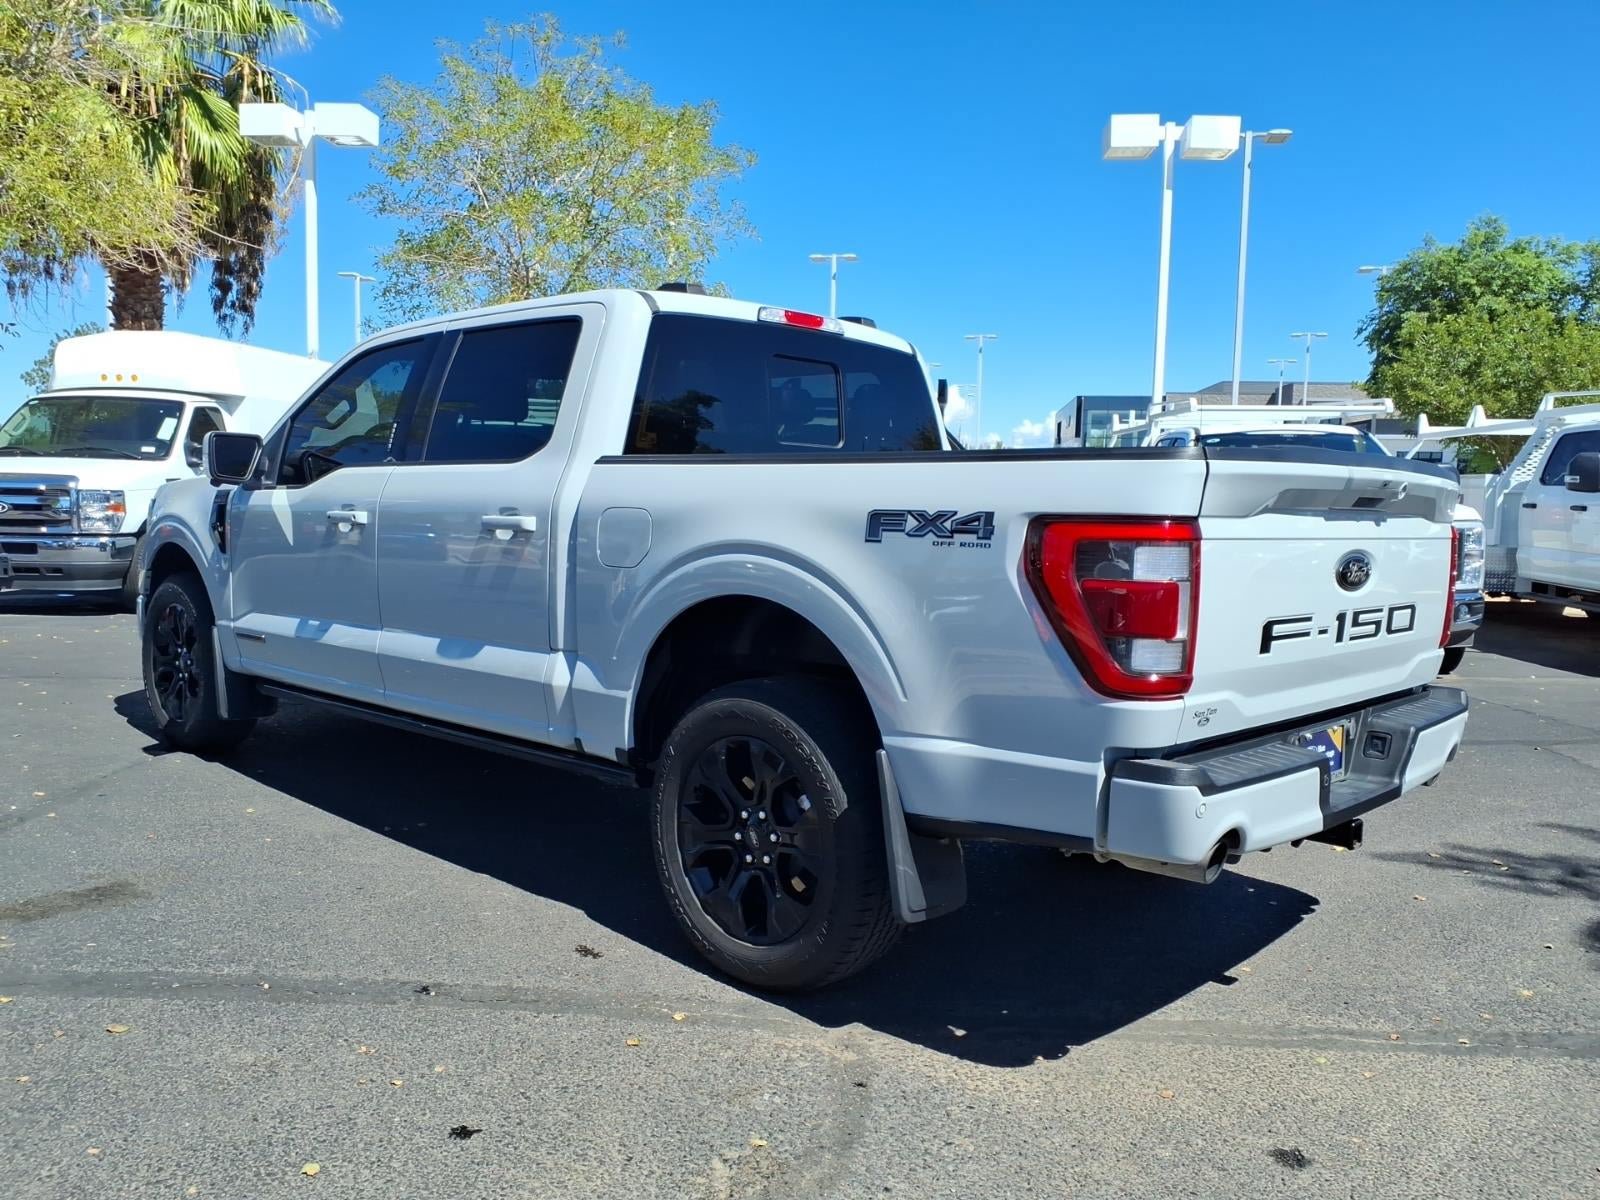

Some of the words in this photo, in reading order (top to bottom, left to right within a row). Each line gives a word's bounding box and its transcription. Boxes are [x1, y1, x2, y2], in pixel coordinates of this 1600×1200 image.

[865, 509, 995, 542] FX4
[959, 541, 992, 549] ROAD
[1259, 601, 1417, 655] F-150
